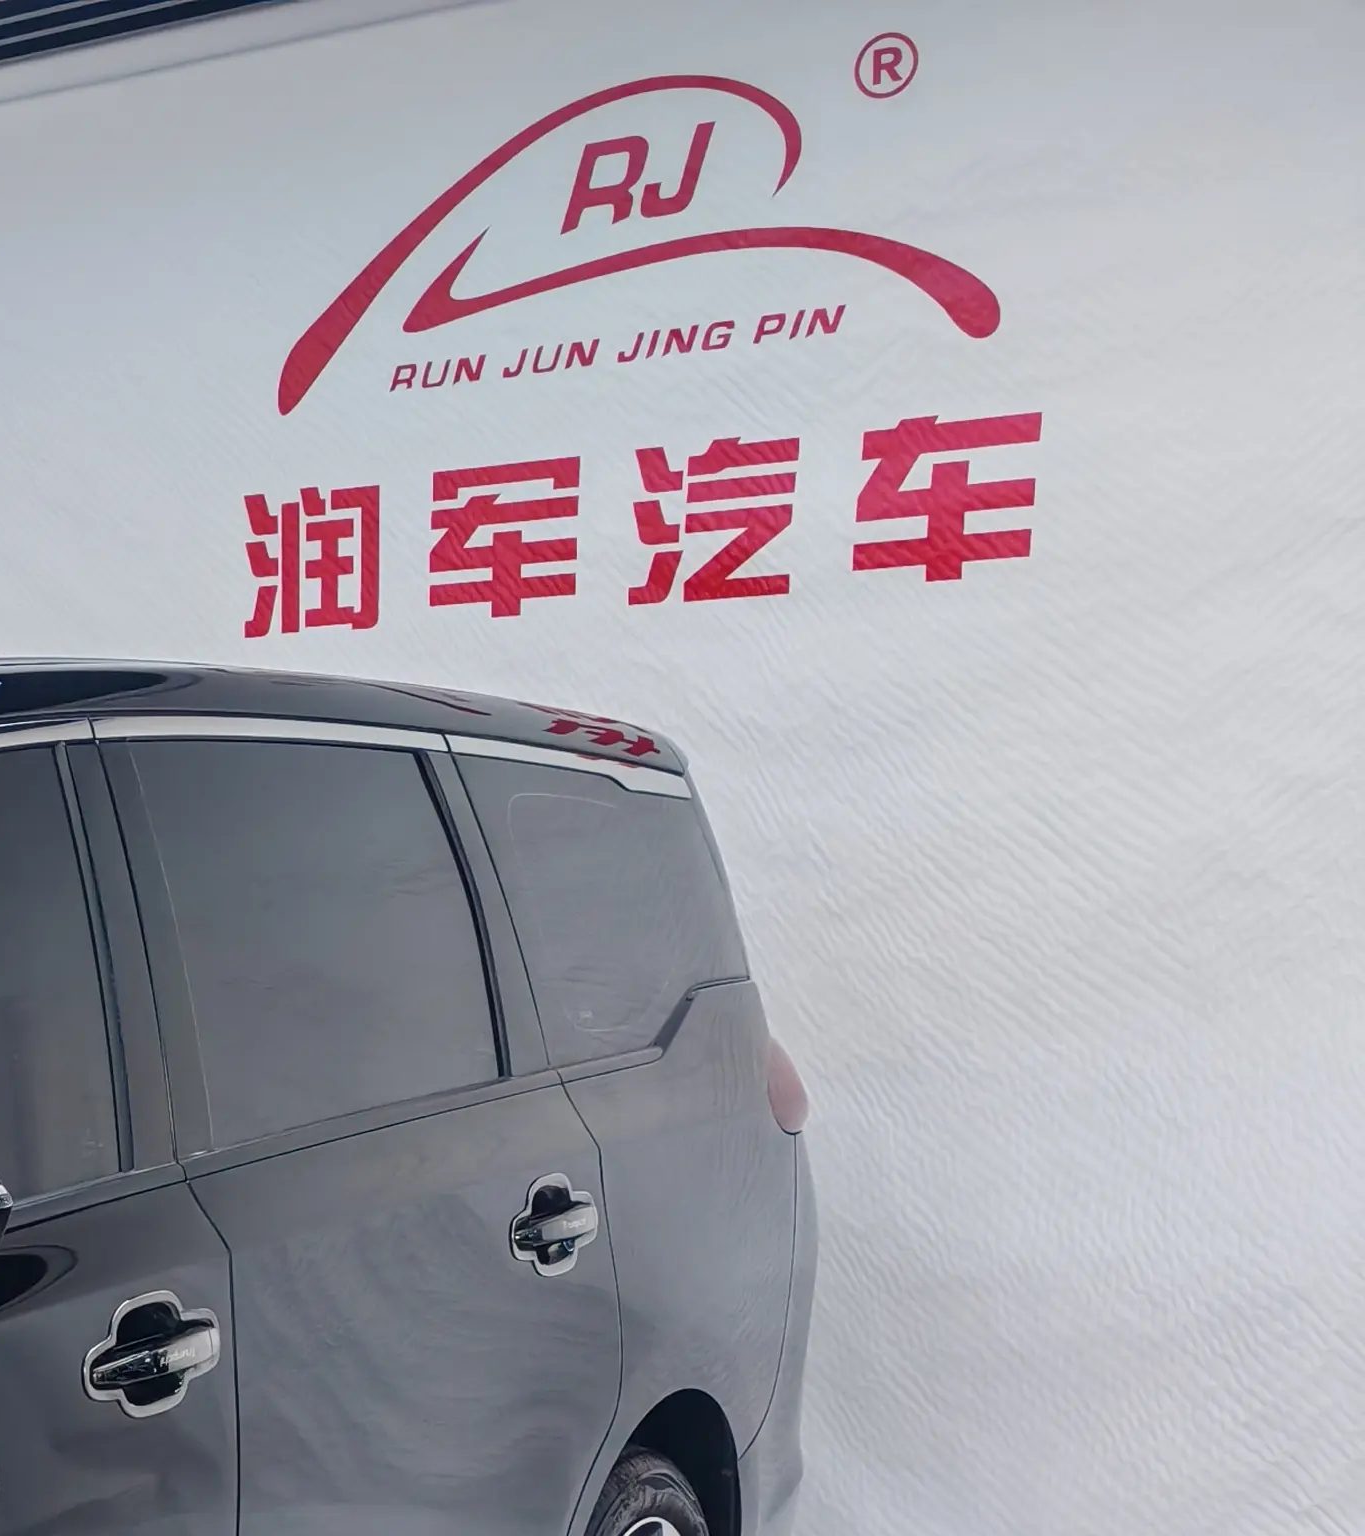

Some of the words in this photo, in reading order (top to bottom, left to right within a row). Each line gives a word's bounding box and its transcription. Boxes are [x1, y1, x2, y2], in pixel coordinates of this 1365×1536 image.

[560, 121, 716, 234] RJ
[390, 354, 486, 392] RUN
[502, 338, 599, 378] JUN
[616, 319, 734, 364] JING
[753, 304, 846, 345] PIN
[243, 411, 1043, 639] 润军汽车
